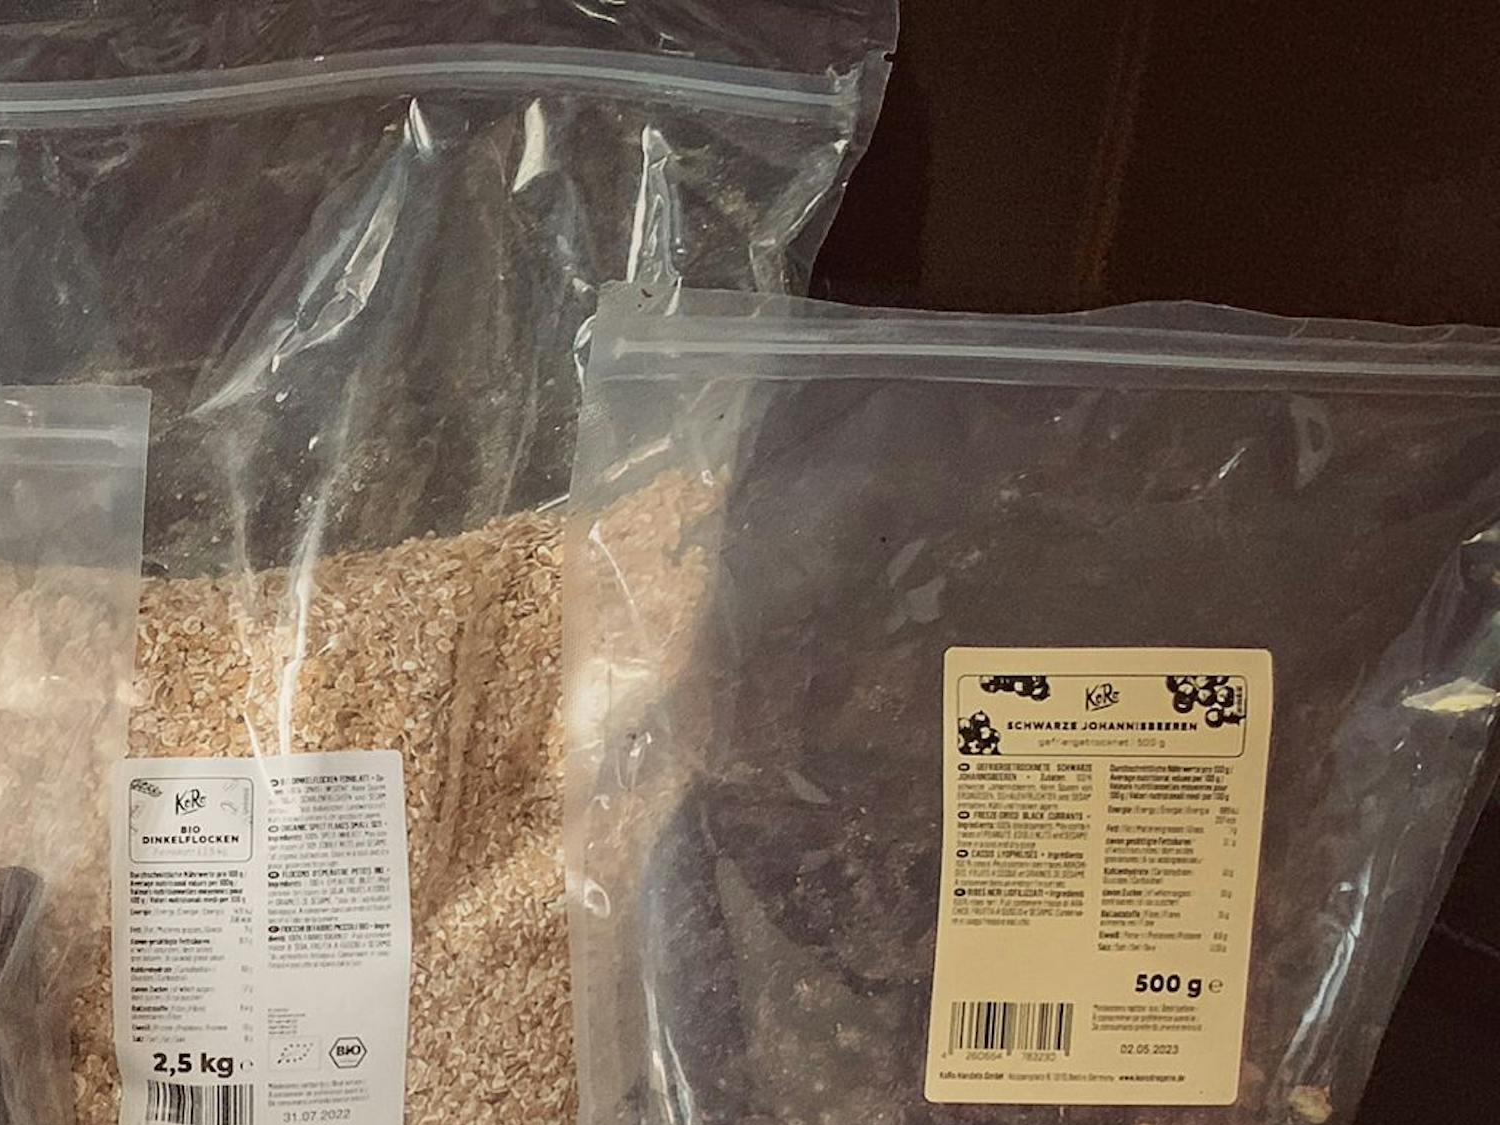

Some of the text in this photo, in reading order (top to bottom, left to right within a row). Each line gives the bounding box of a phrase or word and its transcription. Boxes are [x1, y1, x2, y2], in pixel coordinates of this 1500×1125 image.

[1085, 683, 1120, 711] KoRo
[1007, 721, 1197, 731] SCHWARZE JOHANNISBEEREN
[175, 788, 208, 816] KoRo
[142, 835, 239, 845] DINKELFLOCKEN
[180, 826, 201, 835] BIO
[1135, 974, 1181, 993] 500
[1187, 977, 1203, 997] g
[153, 1052, 234, 1078] 2,5 kg
